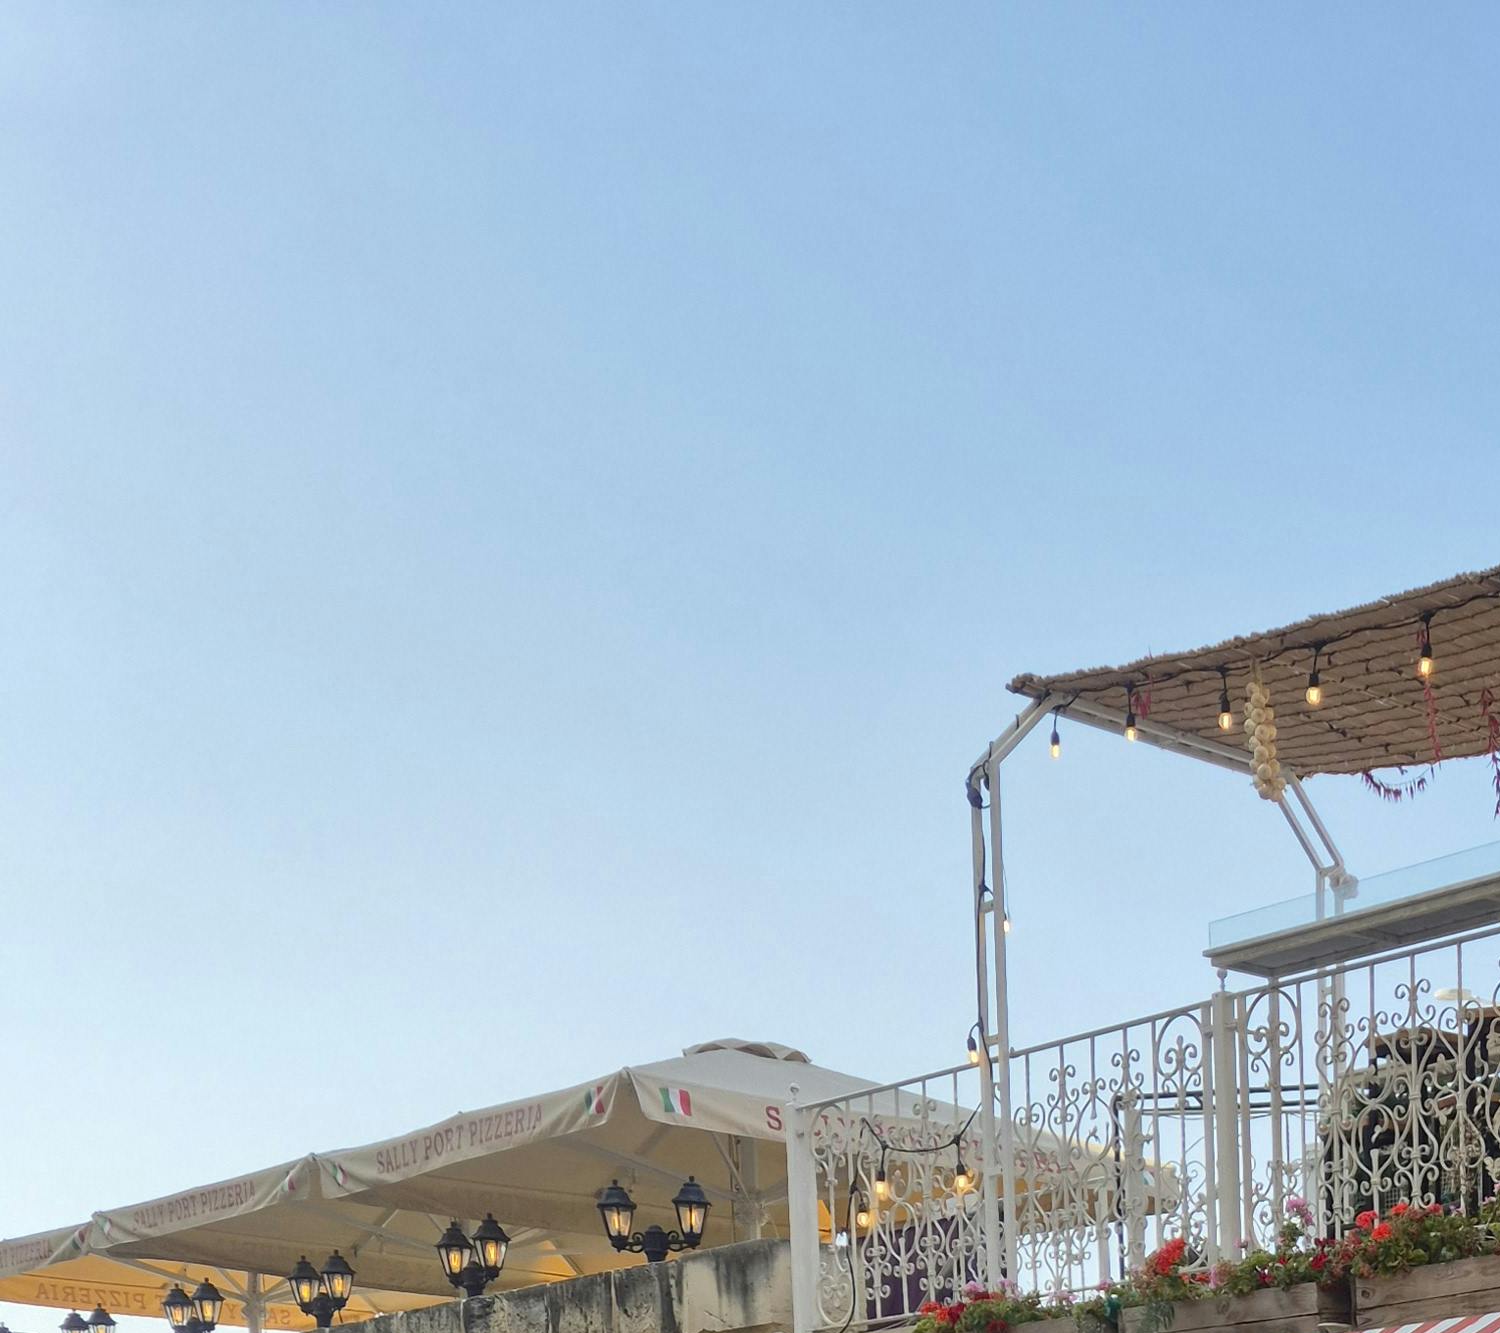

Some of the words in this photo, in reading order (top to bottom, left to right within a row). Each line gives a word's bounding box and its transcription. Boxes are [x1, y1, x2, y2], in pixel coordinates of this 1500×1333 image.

[376, 1138, 418, 1174] SALLY
[424, 1123, 464, 1160] PORT
[469, 1102, 543, 1146] PIZZERIA
[168, 1193, 197, 1222] PORT
[200, 1179, 256, 1213] PIZZERIA
